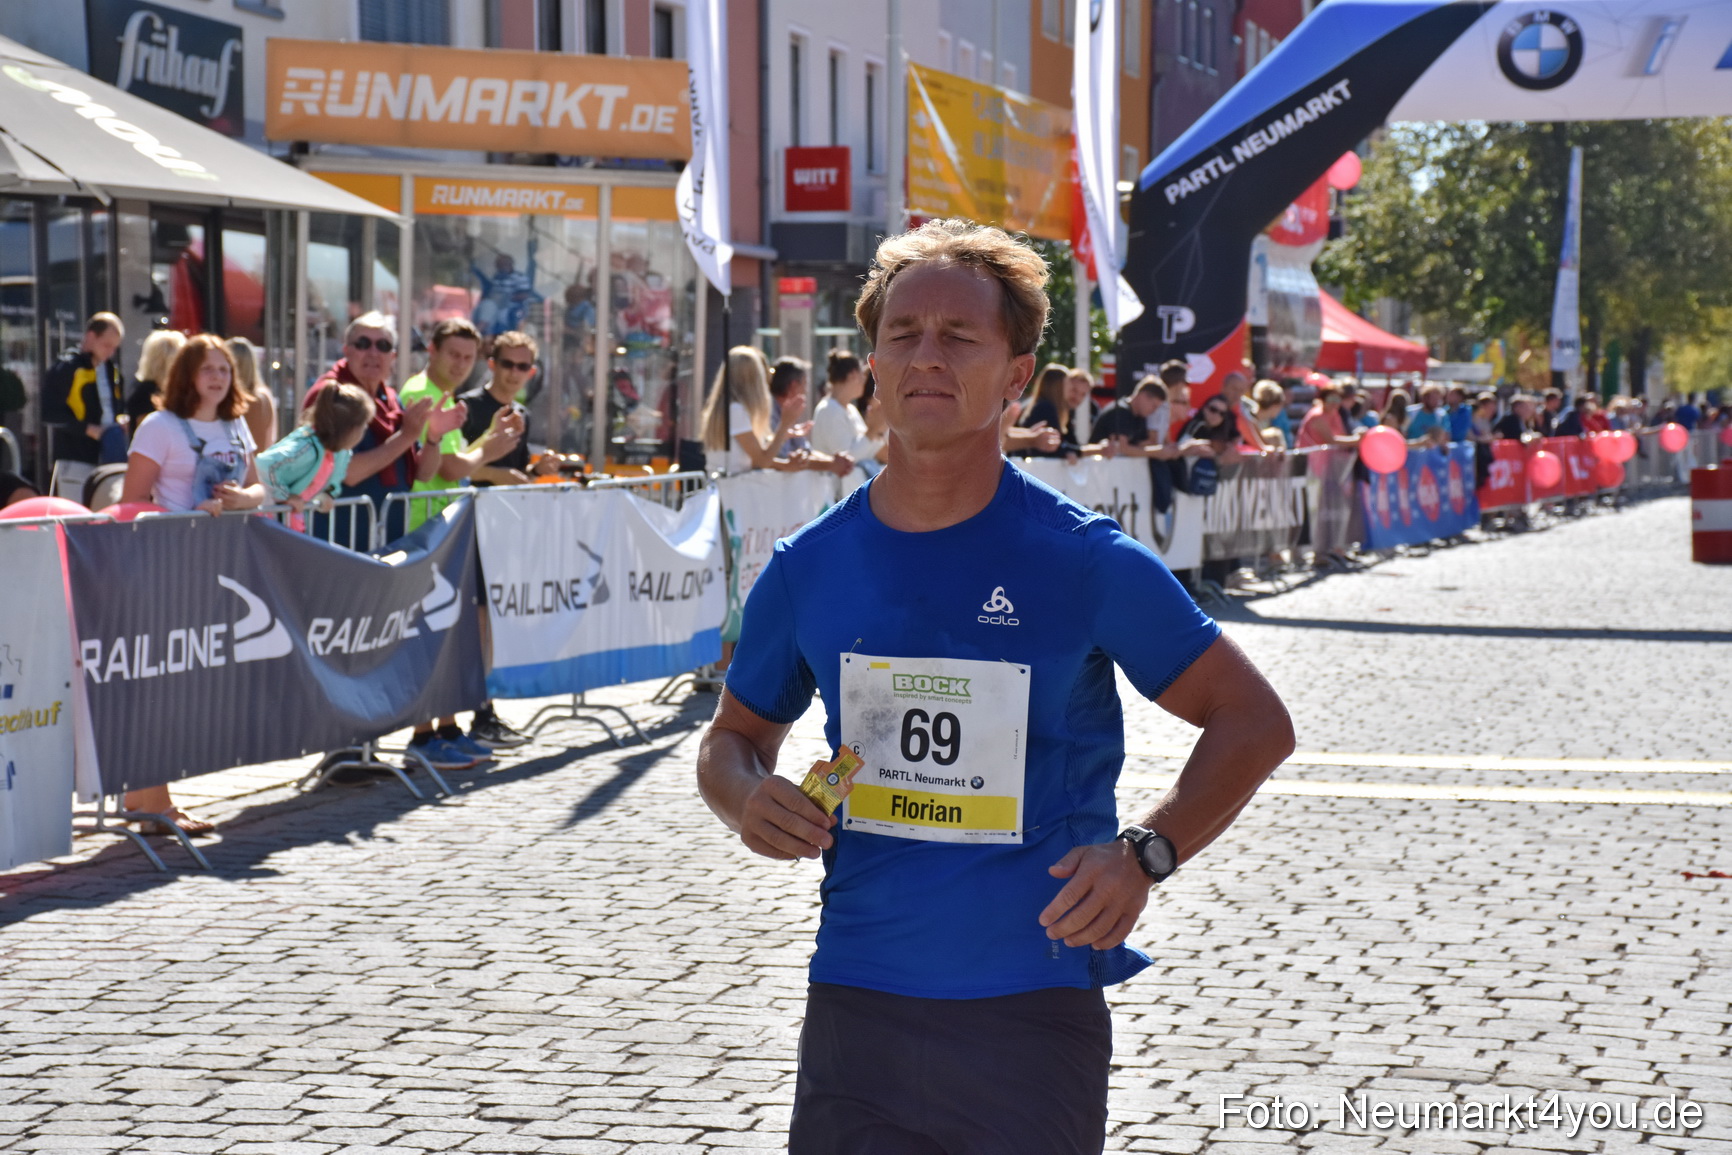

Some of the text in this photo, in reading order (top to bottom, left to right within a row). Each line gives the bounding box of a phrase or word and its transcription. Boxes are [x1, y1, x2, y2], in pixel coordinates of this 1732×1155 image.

[280, 67, 679, 134] RUNMARKT.DE
[1164, 151, 1238, 205] PARTL
[1233, 79, 1352, 169] NEUMARKT
[793, 168, 839, 186] WITT
[431, 185, 585, 211] RUNMARKT.DE
[490, 577, 588, 618] RAIL.ONE
[307, 601, 421, 657] RAIL.ONE
[977, 615, 1020, 626] odlo
[81, 623, 228, 684] RAIL.ONE
[893, 674, 971, 697] BOCK
[894, 692, 918, 700] inspired
[854, 746, 860, 755] C
[900, 708, 961, 766] 69
[879, 768, 966, 788] PARTL Neumarkt
[891, 794, 962, 824] Florian
